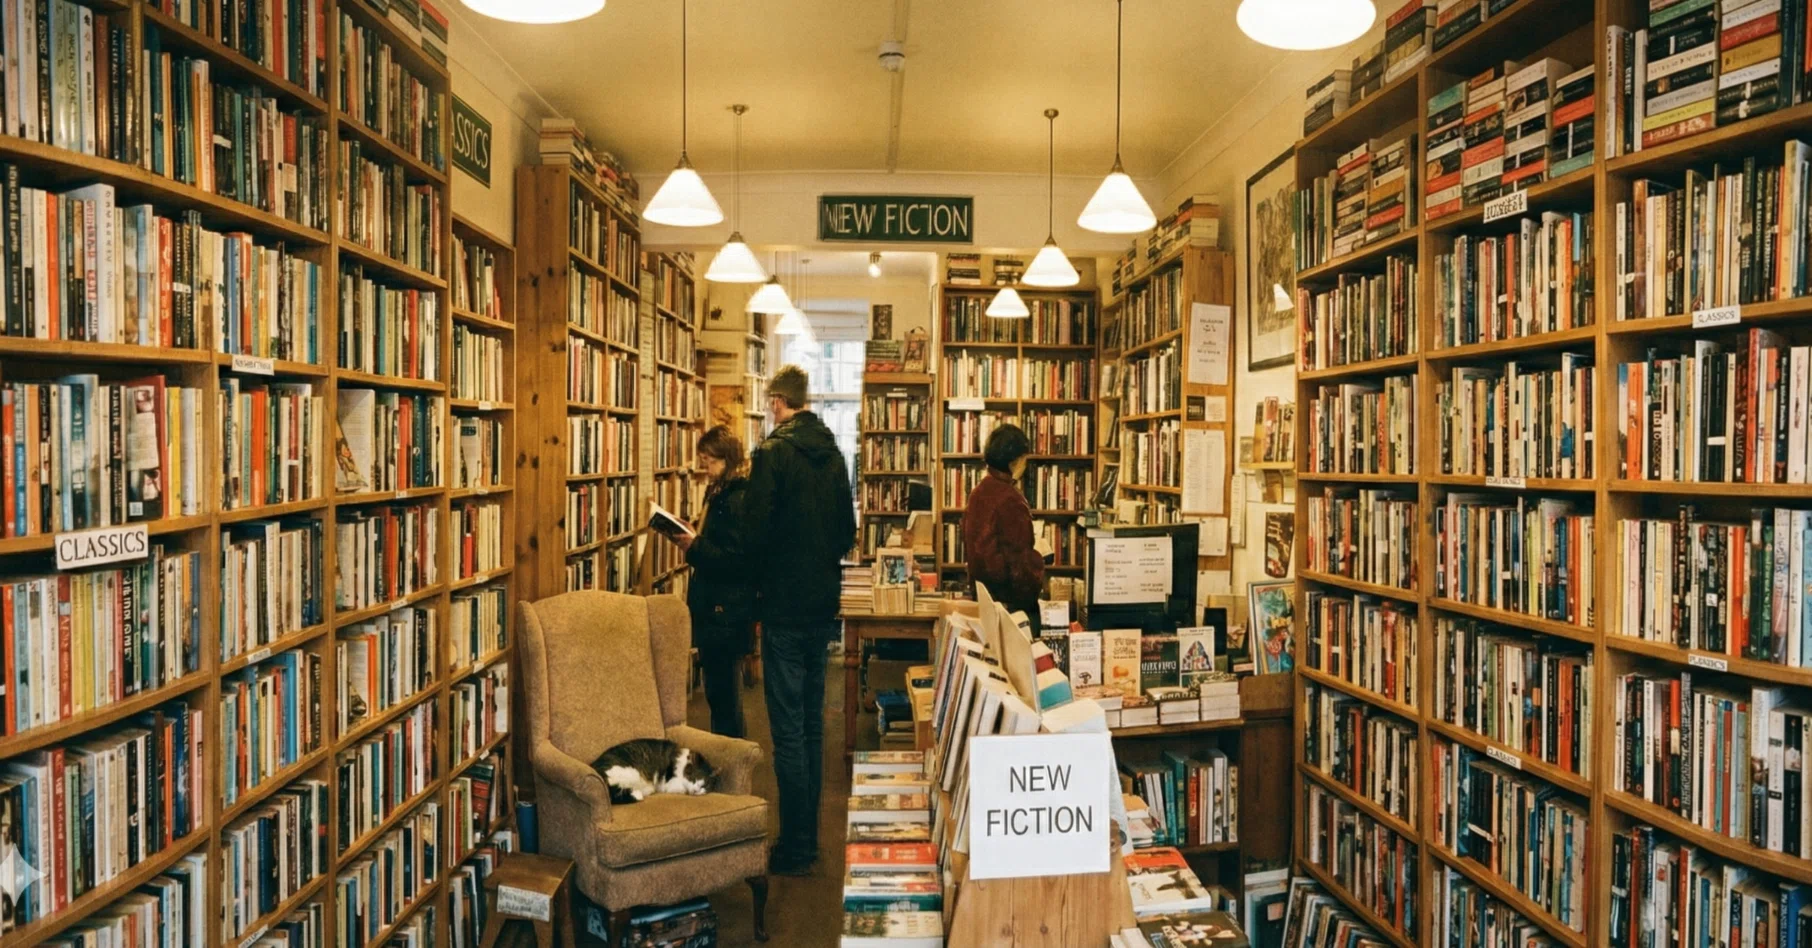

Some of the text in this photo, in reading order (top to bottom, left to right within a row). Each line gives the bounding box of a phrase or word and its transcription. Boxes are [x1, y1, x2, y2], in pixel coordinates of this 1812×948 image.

[825, 202, 969, 237] NEW FICTION
[60, 531, 145, 562] CLASSICS
[1009, 764, 1072, 793] NEW
[986, 805, 1093, 837] FICTION
